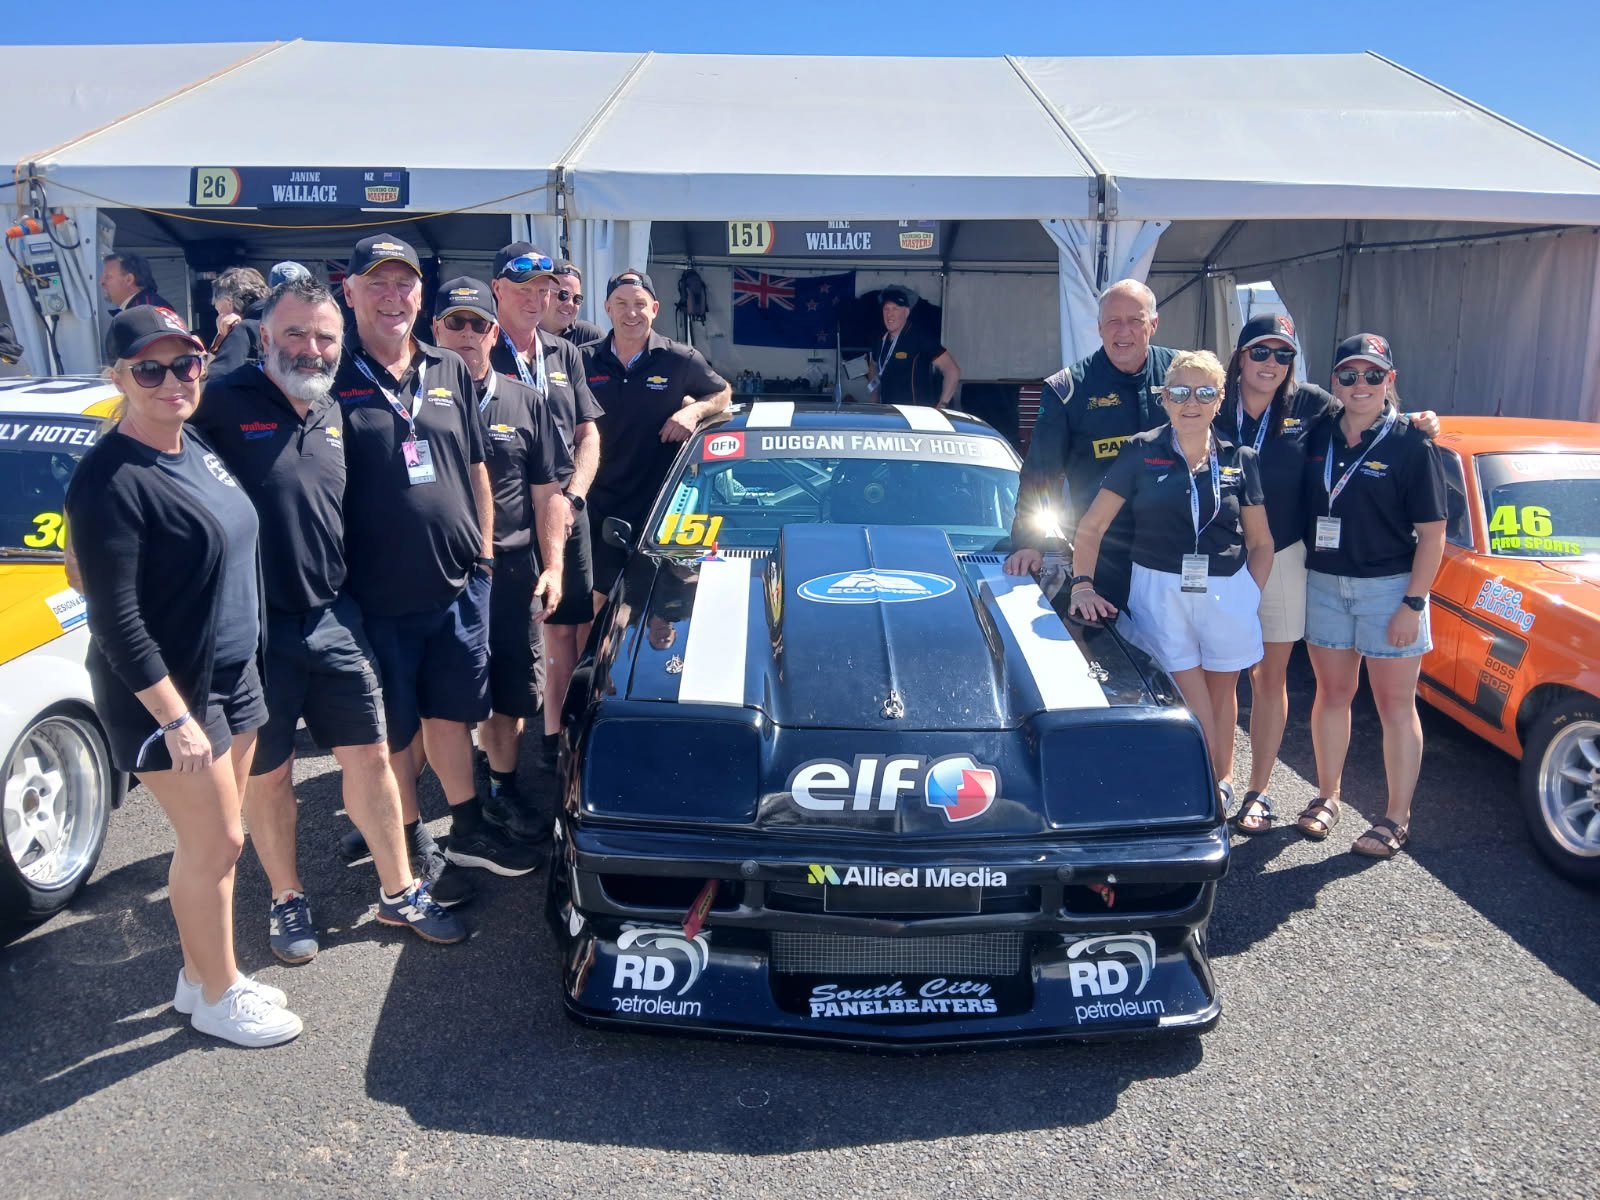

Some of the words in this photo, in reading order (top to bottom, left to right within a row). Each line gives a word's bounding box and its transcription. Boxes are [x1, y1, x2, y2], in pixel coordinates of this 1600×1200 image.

[203, 175, 226, 198] 26
[290, 171, 321, 182] JANINE
[364, 172, 374, 181] NZ
[272, 185, 337, 202] WALLACE
[367, 192, 397, 201] MASTERS
[731, 223, 764, 247] 151
[827, 220, 850, 229] MIKE
[806, 232, 871, 250] WALLACE
[902, 239, 932, 248] MASTERS
[761, 435, 844, 451] DUGGAN
[851, 435, 924, 452] FAMILY
[930, 440, 984, 457] HOTE
[659, 514, 724, 547] 151
[1489, 505, 1553, 537] 46
[1491, 536, 1521, 550] PRO
[1524, 537, 1581, 555] SPORTS
[1482, 578, 1523, 605] pierce
[52, 600, 77, 615] DESIGN
[1472, 592, 1536, 632] plumbing
[1484, 657, 1516, 680] BOSS
[1481, 673, 1510, 694] 302
[791, 758, 920, 811] elf
[843, 866, 918, 888] Allied
[925, 867, 1007, 888] Media
[612, 954, 675, 991] RD
[1068, 960, 1129, 998] RD
[808, 981, 906, 1003] South
[919, 978, 992, 998] City
[810, 999, 998, 1018] PANELBEATERS
[1075, 998, 1165, 1025] petroleum
